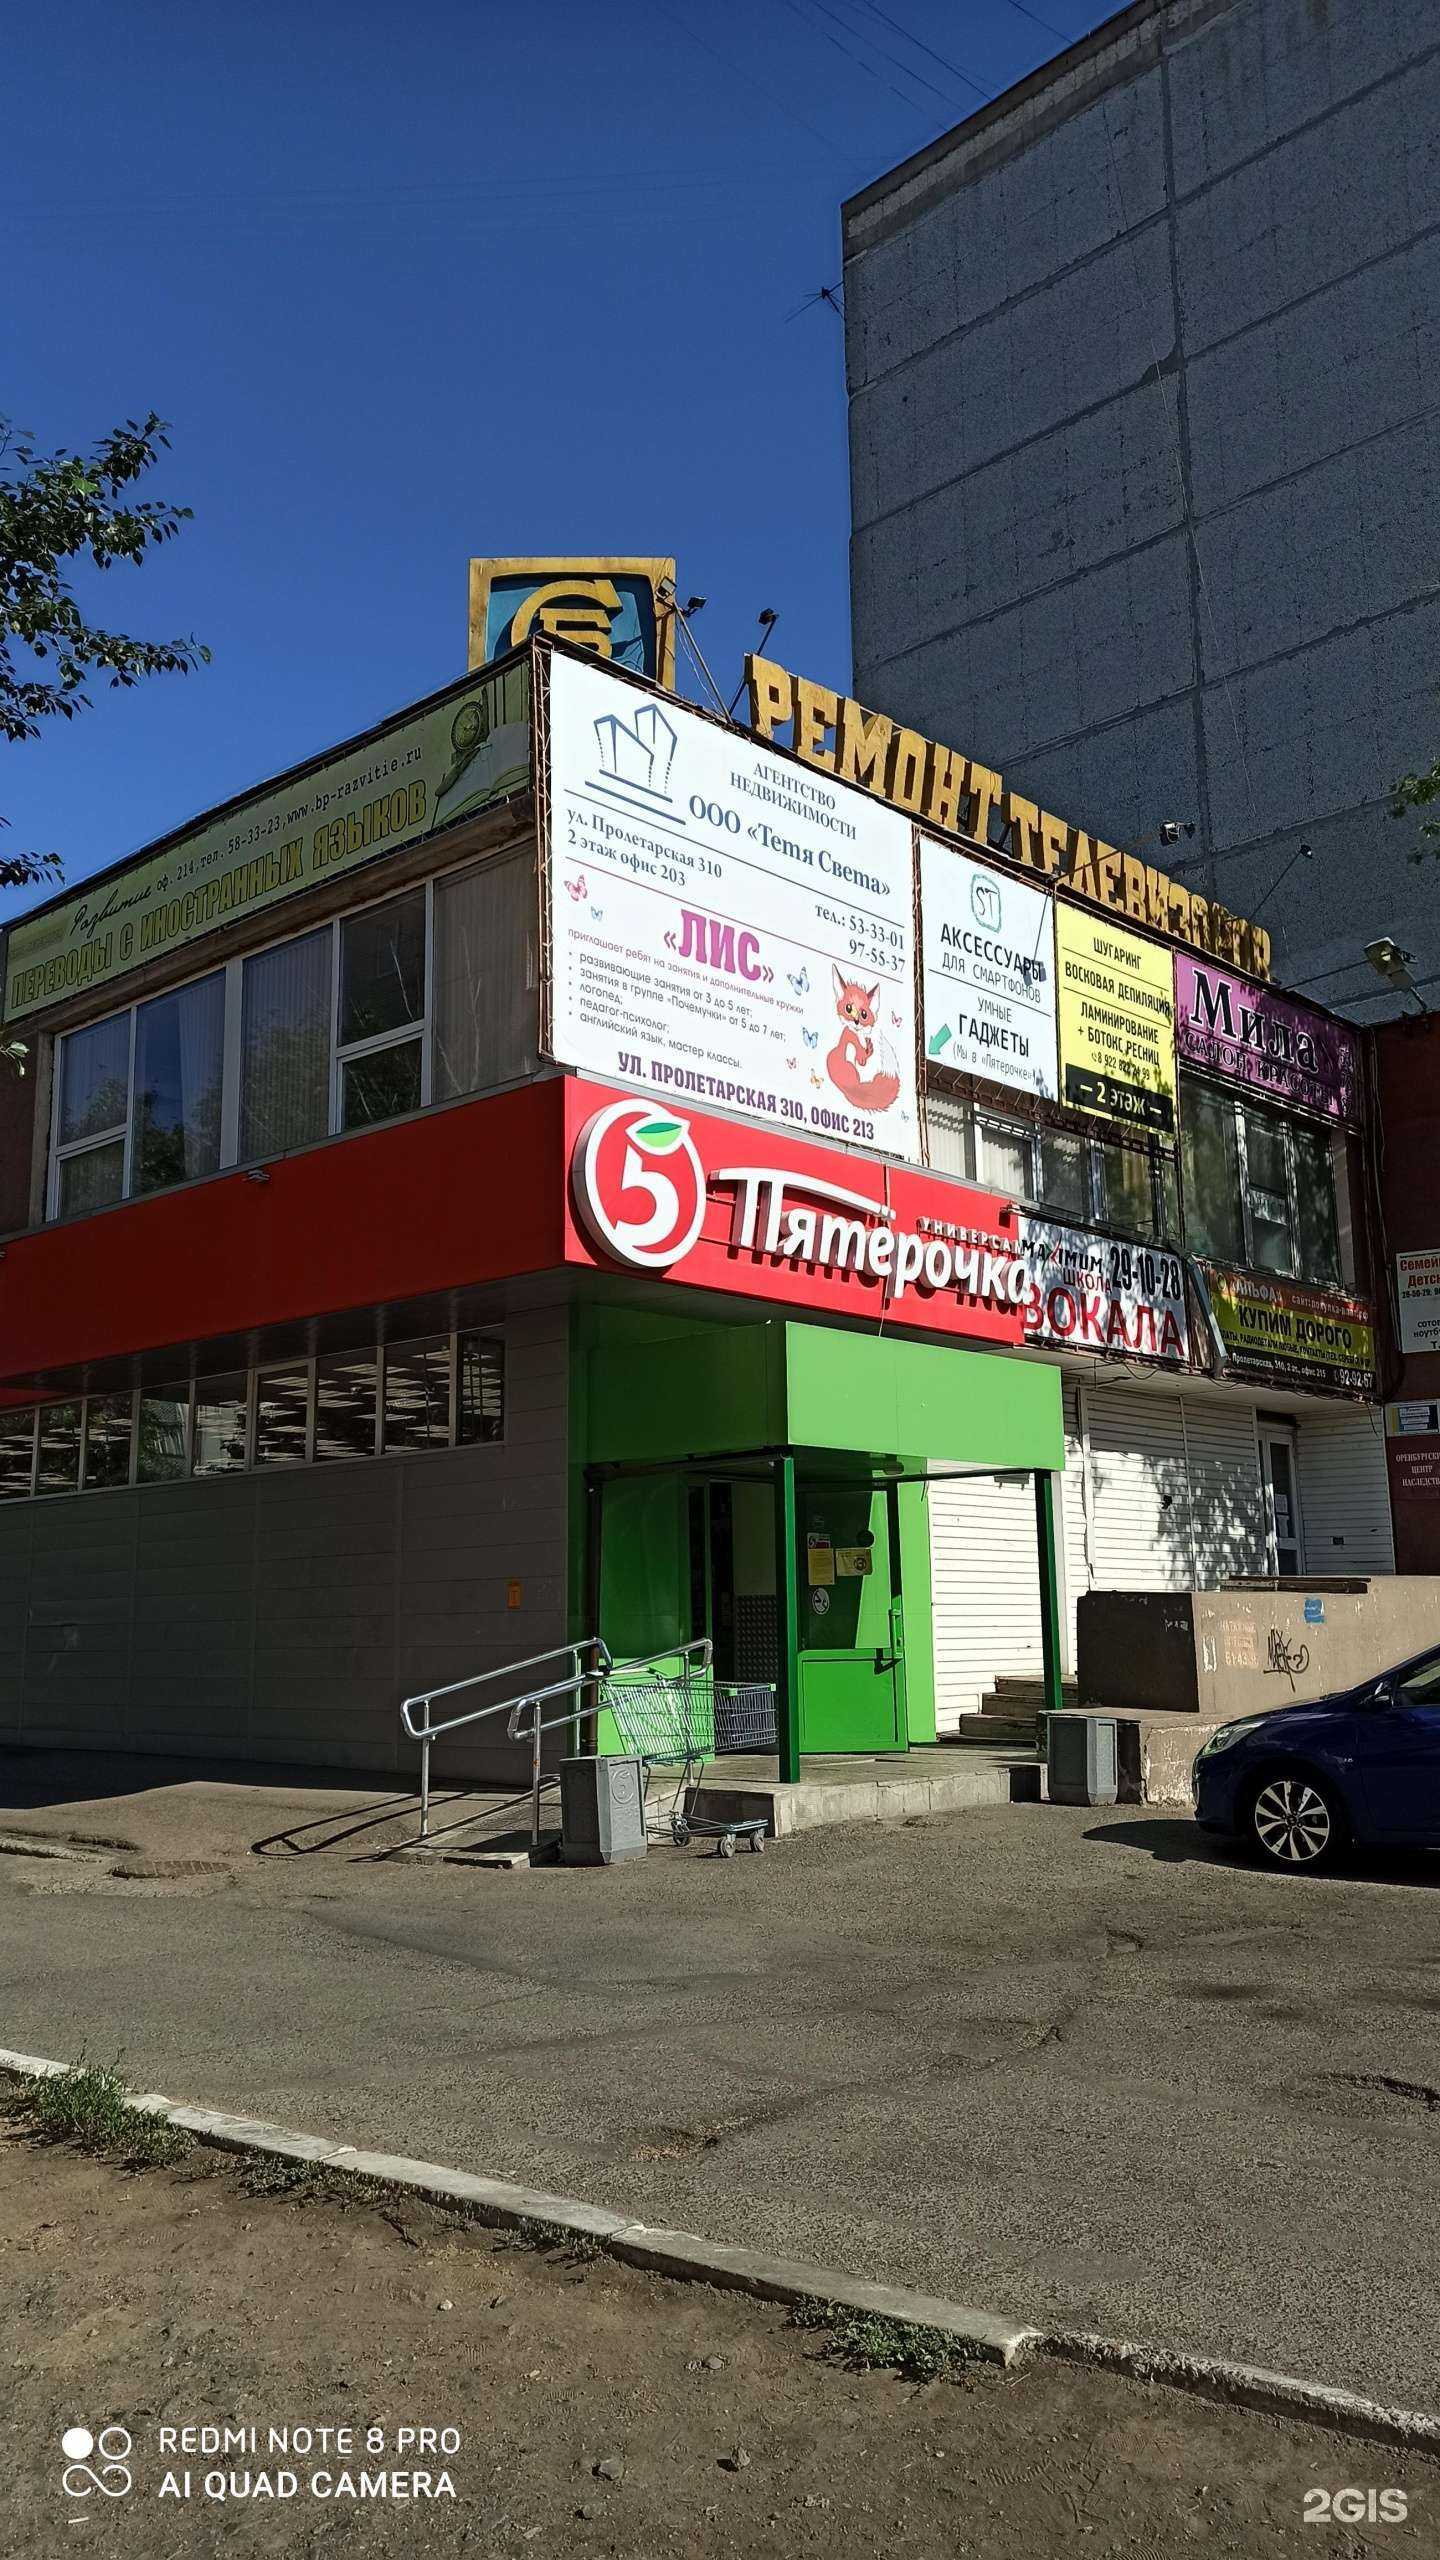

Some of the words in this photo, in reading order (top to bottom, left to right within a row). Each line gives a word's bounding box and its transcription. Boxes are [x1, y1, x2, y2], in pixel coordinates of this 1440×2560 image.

[746, 652, 1003, 844] РЕМОНТ
[730, 772, 857, 841] НЕДВИЖИМОСТИ
[753, 763, 836, 810] АГЕНТСТВО
[567, 808, 588, 827] ул.
[592, 814, 695, 868] Пролетарская
[698, 856, 723, 879] 310
[567, 829, 577, 845] 2
[580, 836, 617, 861] этаж
[620, 852, 658, 875] офис
[661, 864, 687, 887] 203
[688, 795, 741, 834] ООО
[747, 823, 814, 867] «Тетя
[818, 849, 891, 897] Света»
[10, 931, 113, 1010] ПЕРЕВОДЫ
[119, 922, 134, 961] С
[140, 836, 304, 952] ИНОСТРАННЫХ
[313, 779, 427, 870] ЯЗЫКОВ
[568, 928, 624, 955] приглашает
[625, 947, 651, 964] ребят
[653, 958, 665, 968] на
[668, 961, 701, 981] занятия
[663, 908, 775, 984] «ЛИС»
[815, 904, 846, 928] тел.:
[849, 915, 905, 951] 53-33-01
[940, 923, 1043, 982] АКСЕССУАРЫ
[1093, 937, 1141, 970] ШУГАРИНГ
[579, 952, 651, 985] развивающие
[653, 977, 691, 997] занятия
[693, 989, 702, 1000] от
[705, 993, 712, 1004] 3
[714, 997, 726, 1009] до
[728, 1000, 734, 1011] 5
[849, 939, 906, 974] 97-55-37
[942, 952, 965, 974] ДЛЯ
[972, 963, 1041, 1004] СМАРТФОНОВ
[579, 967, 620, 988] занятия
[622, 982, 628, 991] в
[630, 984, 664, 1003] группе
[729, 1017, 738, 1026] от
[741, 1017, 747, 1029] 5
[749, 1023, 760, 1034] до
[762, 1024, 768, 1035] 7
[977, 996, 1012, 1024] УМНЫЕ
[1065, 961, 1115, 994] ВОСКОВАЯ
[1118, 983, 1171, 1018] ДЕПИЛЯЦИЯ
[579, 1012, 638, 1038] английский
[640, 1031, 666, 1047] язык,
[669, 1040, 705, 1059] мастер
[706, 1051, 743, 1069] классы.
[958, 1013, 1029, 1058] ГАДЖЕТЫ
[1080, 1001, 1159, 1045] ЛАМИНИРОВАНИЕ
[1088, 1026, 1123, 1053] БОТОКС
[1126, 1041, 1160, 1068] РЕСНИЦ
[1189, 966, 1319, 1074] Мила
[617, 1051, 647, 1078] УЛ.
[651, 1060, 777, 1113] ПРОЛЕТАРСКАЯ
[780, 1098, 808, 1123] 310,
[810, 1106, 850, 1132] ОФИС
[852, 1119, 875, 1140] 213
[1097, 1082, 1106, 1104] 2
[1183, 1030, 1249, 1073] САЛОН
[1256, 1058, 1333, 1107] КРАСОТЫ
[918, 1215, 1024, 1255] УНИВЕРСАМ
[1063, 1267, 1112, 1293] ШКОЛА
[1110, 1245, 1181, 1301] 29-10-28
[1023, 1282, 1185, 1357] ВОКАЛА
[1238, 1304, 1292, 1337] КУПИМ
[1295, 1318, 1352, 1349] ДОРОГО
